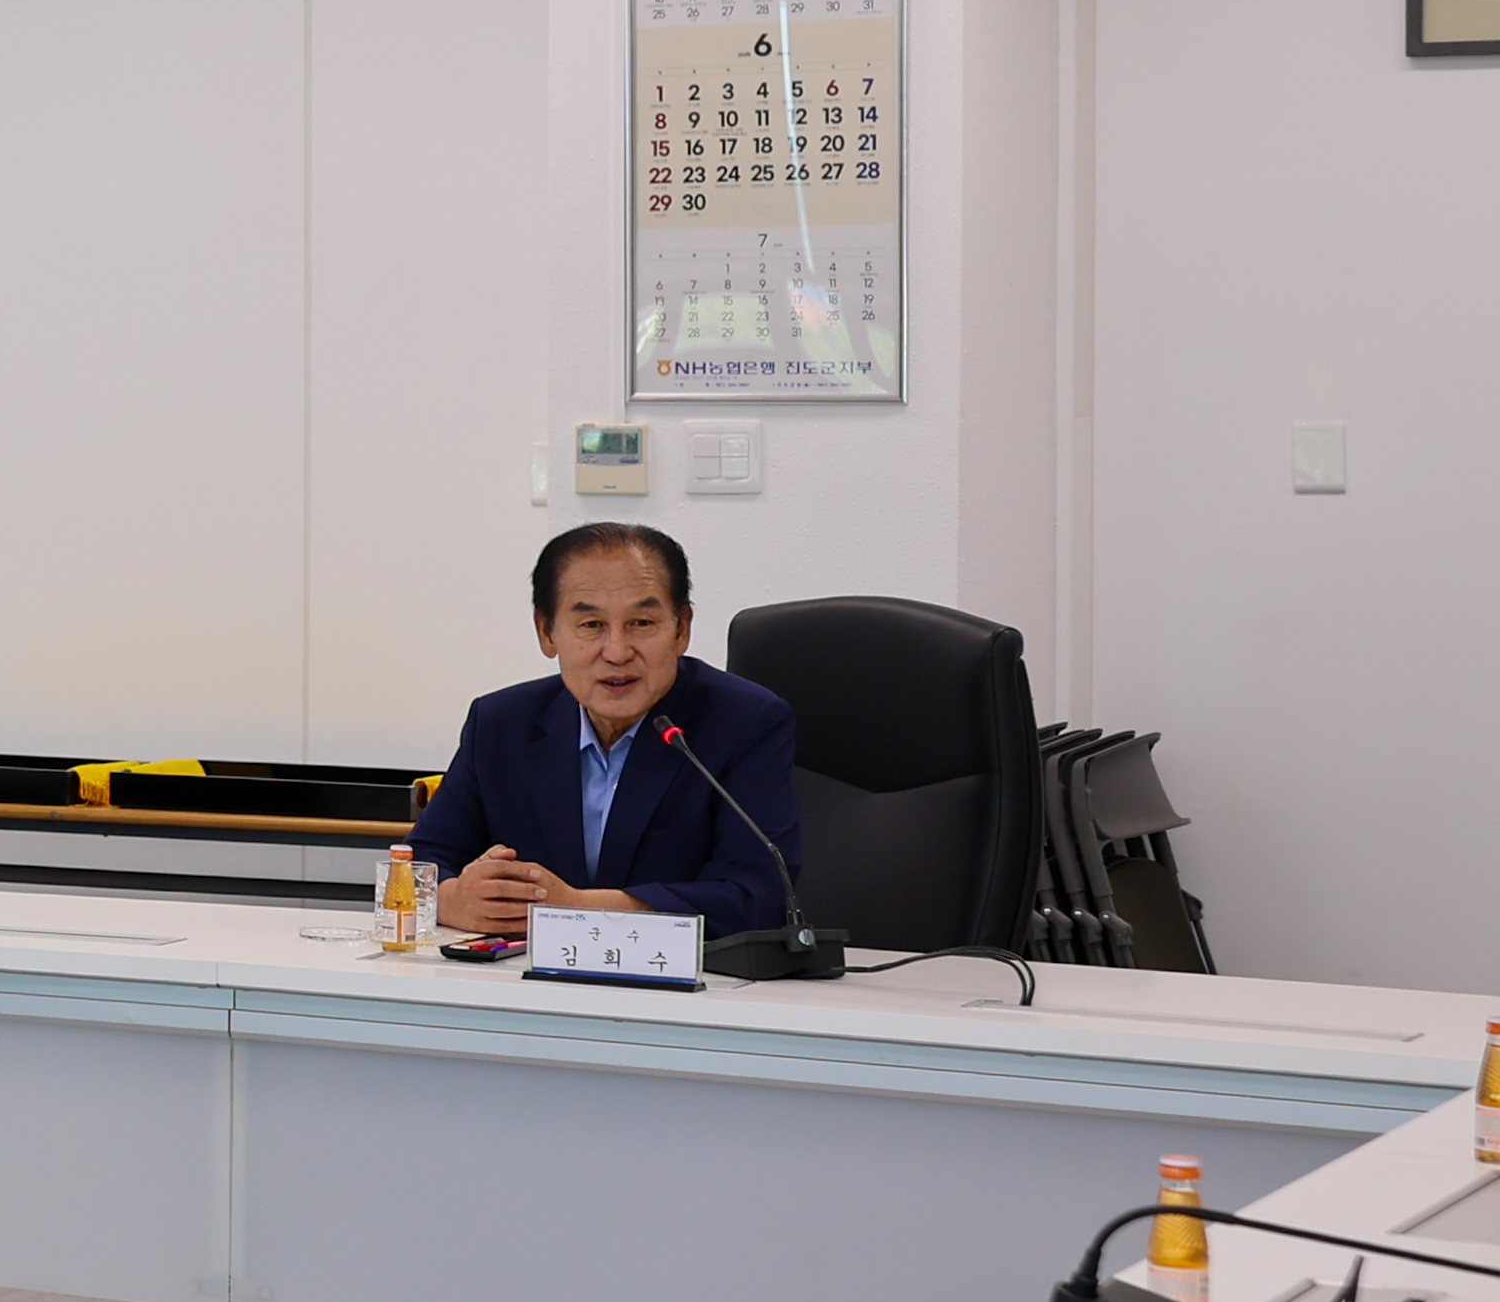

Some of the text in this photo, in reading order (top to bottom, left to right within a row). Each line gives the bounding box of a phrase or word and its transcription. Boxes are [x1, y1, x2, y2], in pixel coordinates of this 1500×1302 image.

[653, 0, 874, 20] 25 26 27 28 29 30 31
[753, 33, 772, 57] 6
[656, 78, 874, 102] 1 2 3 4 5 6 7
[654, 113, 667, 130] 8
[688, 111, 701, 129] 9
[718, 110, 739, 128] 10
[755, 109, 769, 126] 11
[822, 107, 843, 124] 13
[857, 106, 878, 123] 14
[651, 134, 877, 157] 15 16 17 18 19 20 21
[649, 161, 880, 184] 22 23 24 25 26 27 28
[649, 193, 706, 212] 29 30
[758, 233, 768, 247] 7
[759, 262, 766, 274] 2
[794, 262, 802, 273] 3
[829, 262, 837, 272] 4
[864, 261, 873, 272] 5
[656, 277, 874, 291] 6 7 8 9 10 11 12
[722, 294, 734, 306] 15
[758, 295, 769, 306] 16
[827, 294, 839, 305] 18
[863, 294, 874, 304] 19
[688, 311, 699, 323] 21
[721, 311, 735, 322] 22
[756, 311, 770, 321] 23
[862, 310, 876, 321] 26
[687, 327, 701, 338] 28
[721, 327, 735, 338] 29
[755, 326, 770, 338] 30
[791, 326, 802, 338] 31
[674, 360, 873, 377] NH농협은행 진도군지부
